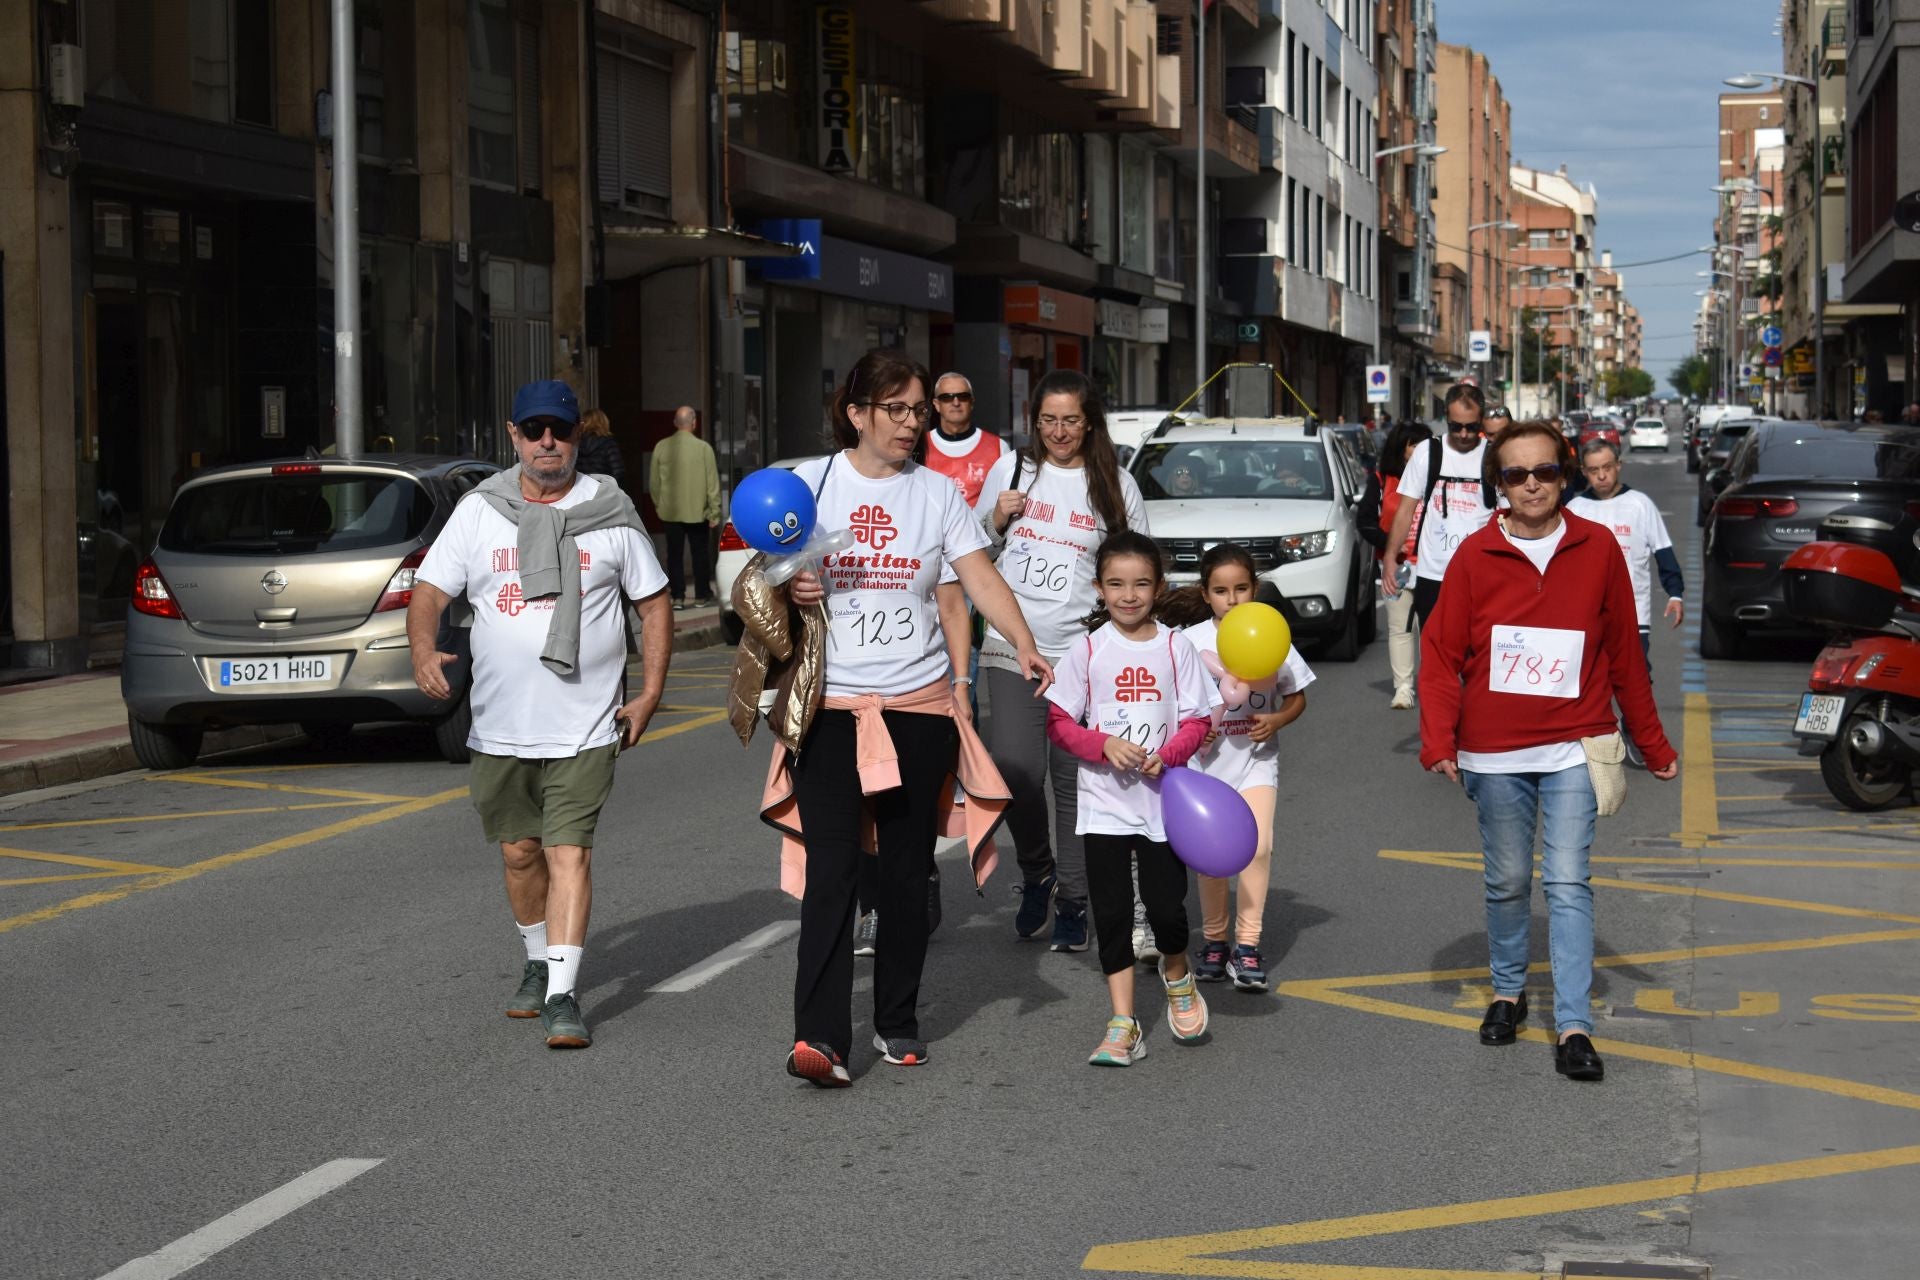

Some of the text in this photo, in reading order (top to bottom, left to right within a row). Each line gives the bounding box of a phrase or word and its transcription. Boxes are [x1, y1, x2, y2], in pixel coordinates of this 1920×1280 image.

[822, 9, 850, 168] GESTORIA
[859, 257, 880, 286] BBVA
[928, 272, 947, 299] BBVA
[1070, 511, 1096, 528] berlin
[822, 551, 922, 570] Cáritas
[830, 569, 914, 580] Interparroquial
[1017, 556, 1068, 591] 136
[836, 580, 907, 590] de Calahorra
[851, 607, 914, 646] 123
[1497, 642, 1524, 650] Calahorra
[232, 660, 325, 682] 5021 HHD
[1502, 653, 1568, 684] 785
[1810, 697, 1840, 714] 9801
[1805, 714, 1829, 731] HDB
